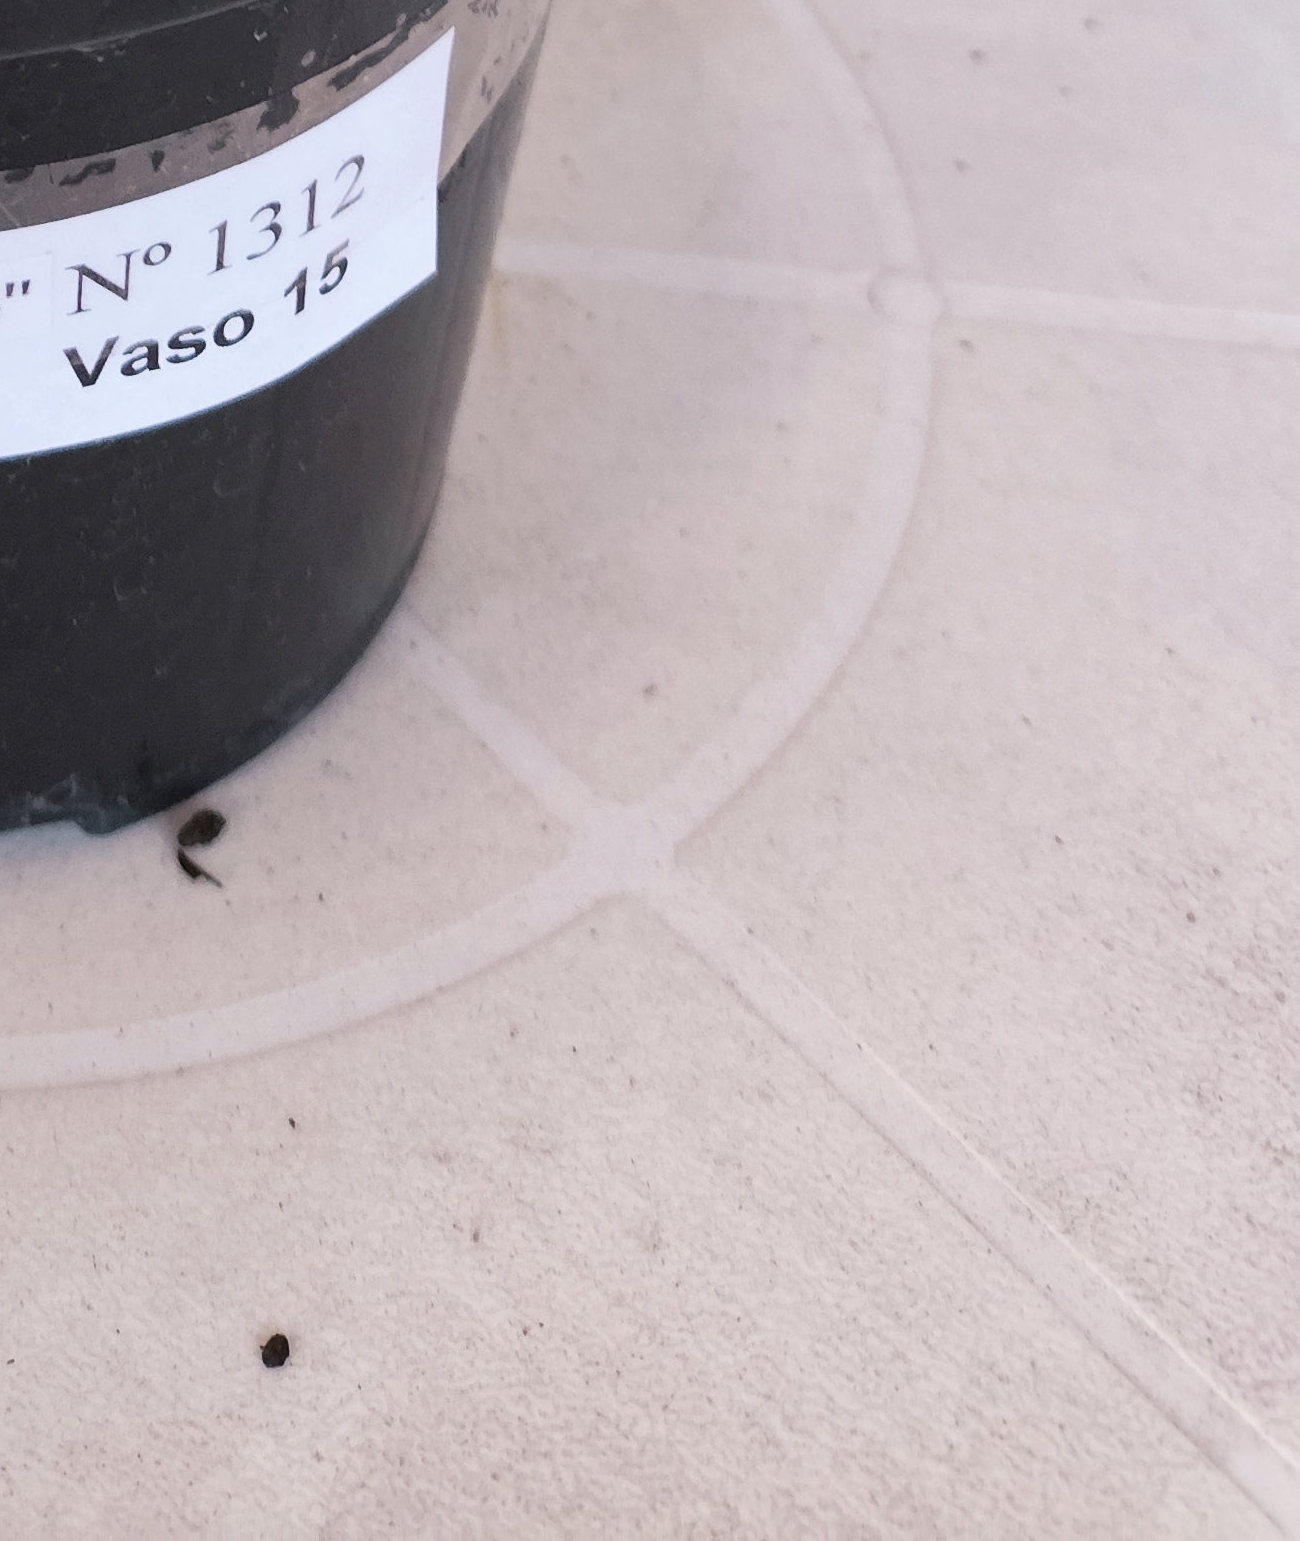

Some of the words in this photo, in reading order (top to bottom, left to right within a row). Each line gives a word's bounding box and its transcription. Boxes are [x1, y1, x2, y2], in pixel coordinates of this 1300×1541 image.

[207, 154, 366, 277] 1312
[63, 308, 255, 388] Vaso
[284, 239, 351, 316] 15
